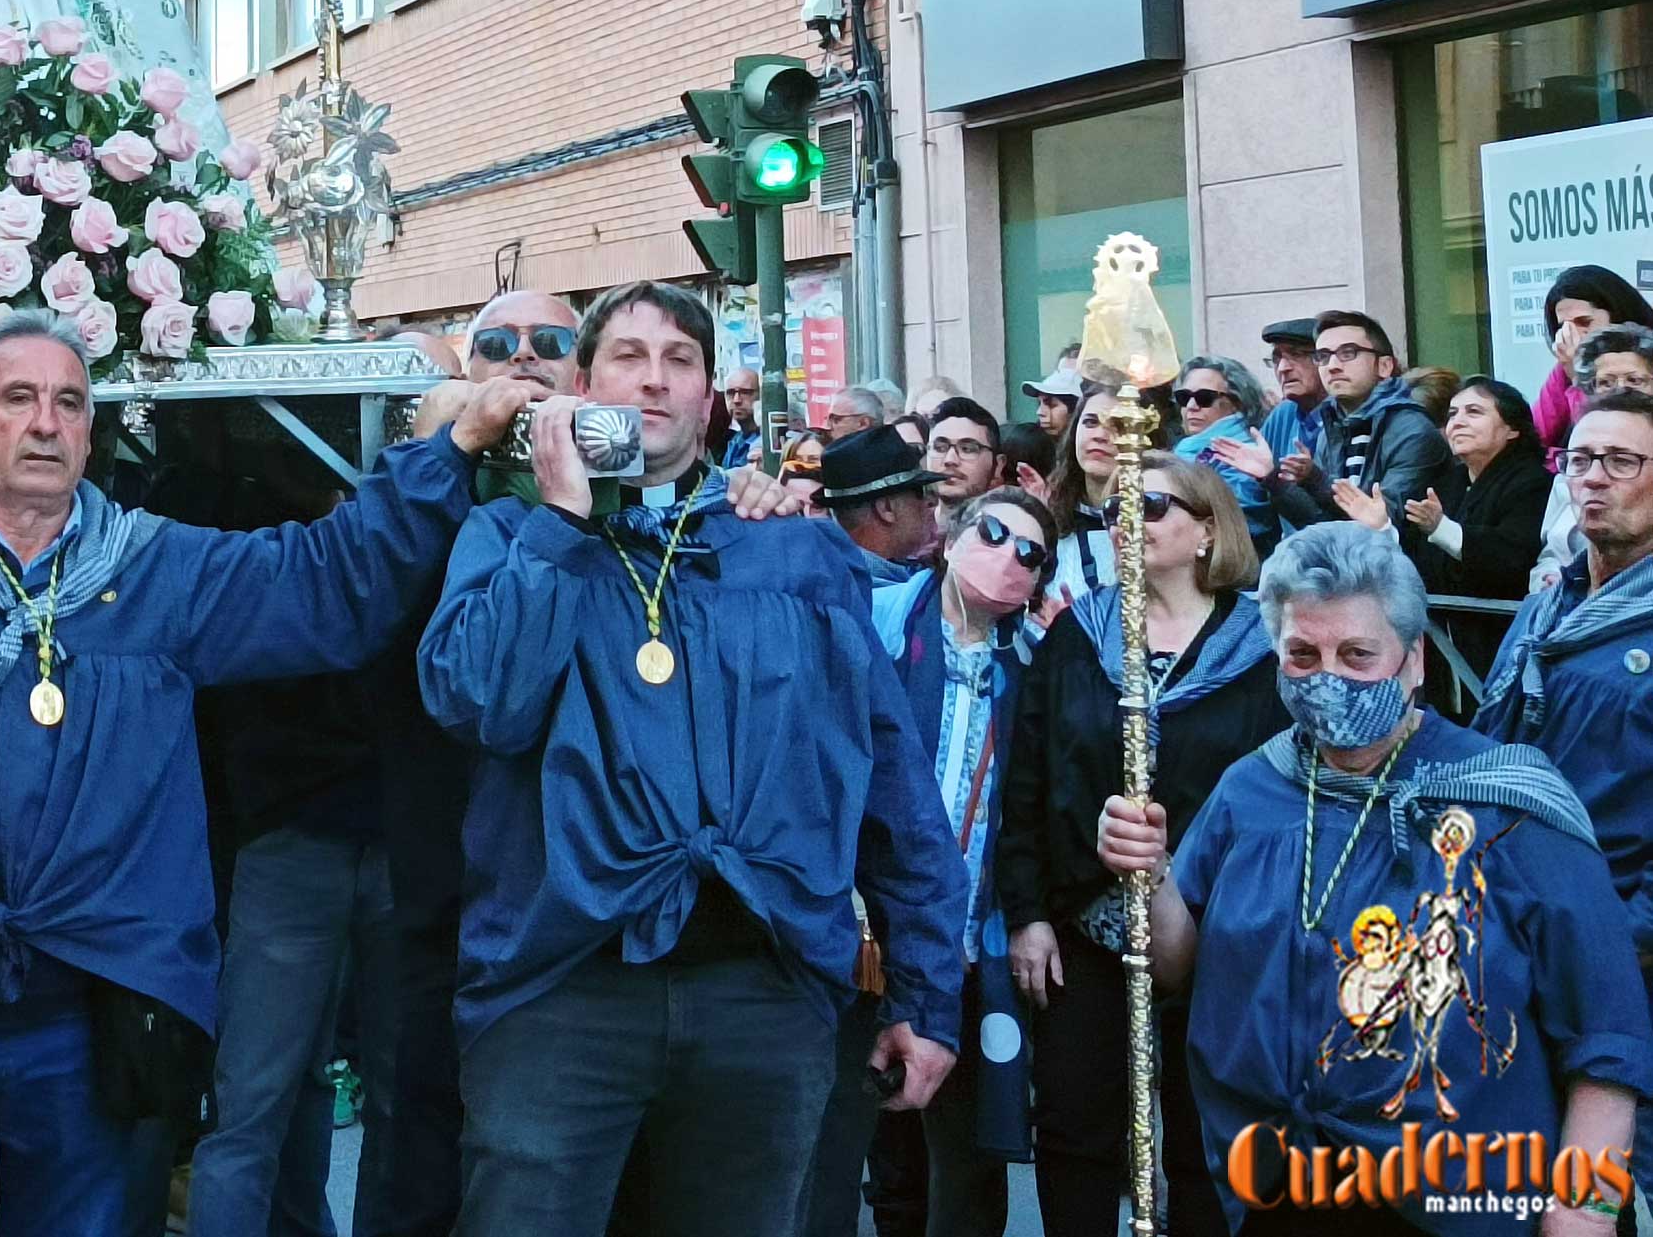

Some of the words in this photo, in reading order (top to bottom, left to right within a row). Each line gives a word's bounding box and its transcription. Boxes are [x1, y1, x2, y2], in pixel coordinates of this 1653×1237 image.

[1508, 181, 1598, 243] SOMOS
[1512, 269, 1532, 285] PARA
[1514, 296, 1533, 311] PARA
[1516, 323, 1535, 337] PARA
